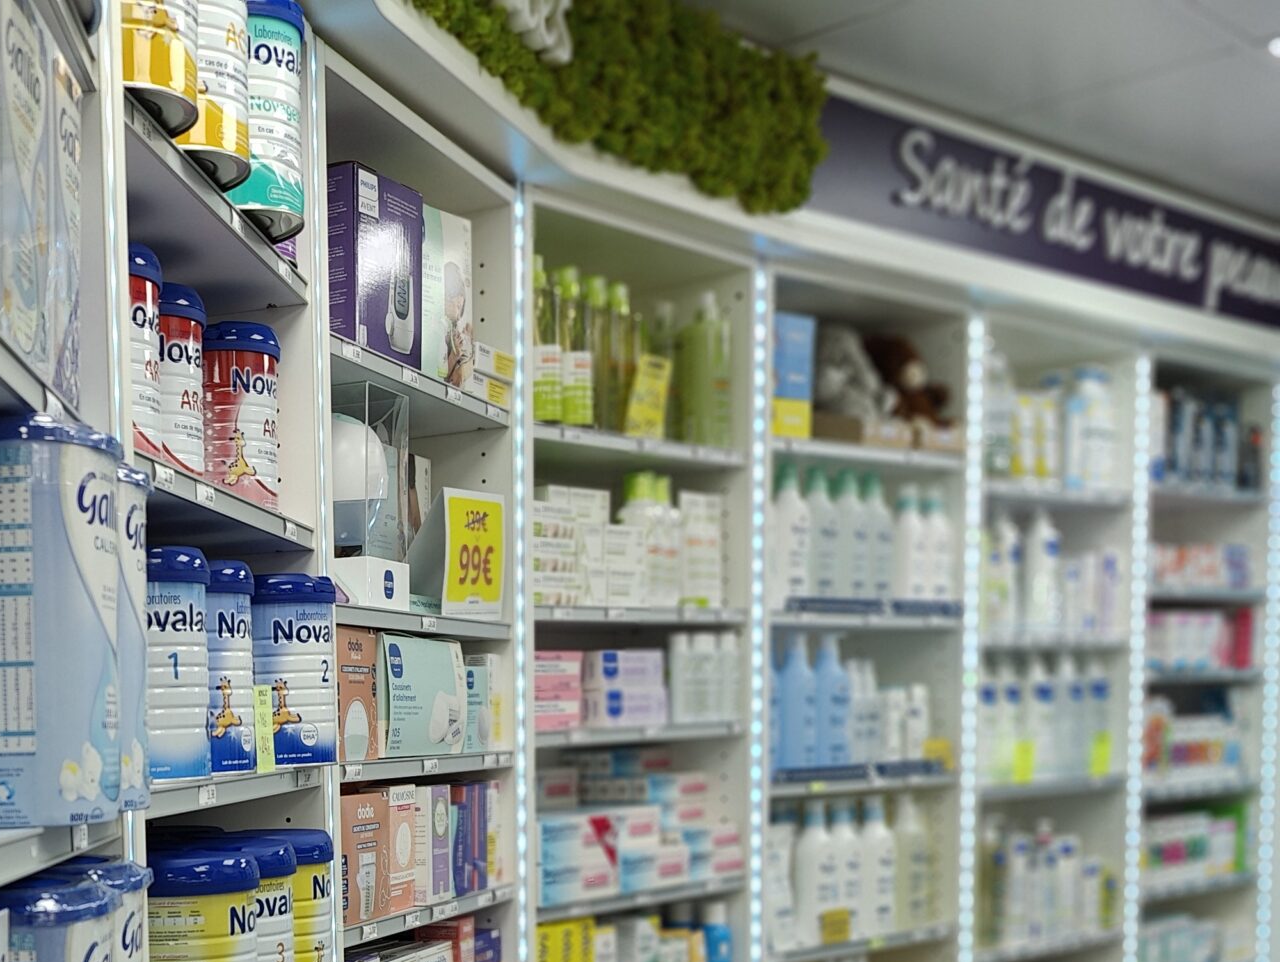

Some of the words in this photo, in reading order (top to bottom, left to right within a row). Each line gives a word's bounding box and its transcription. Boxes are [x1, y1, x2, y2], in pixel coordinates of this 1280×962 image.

[247, 34, 302, 77] oval
[359, 179, 377, 193] PHILIPS
[360, 200, 377, 212] AVENT
[892, 127, 1033, 232] Santé
[1042, 166, 1094, 252] de
[1103, 207, 1202, 282] votre
[458, 543, 495, 586] 99€
[295, 609, 329, 622] Laboratoires
[167, 651, 180, 682] 1
[320, 659, 330, 684] 2
[357, 803, 375, 820] dodie
